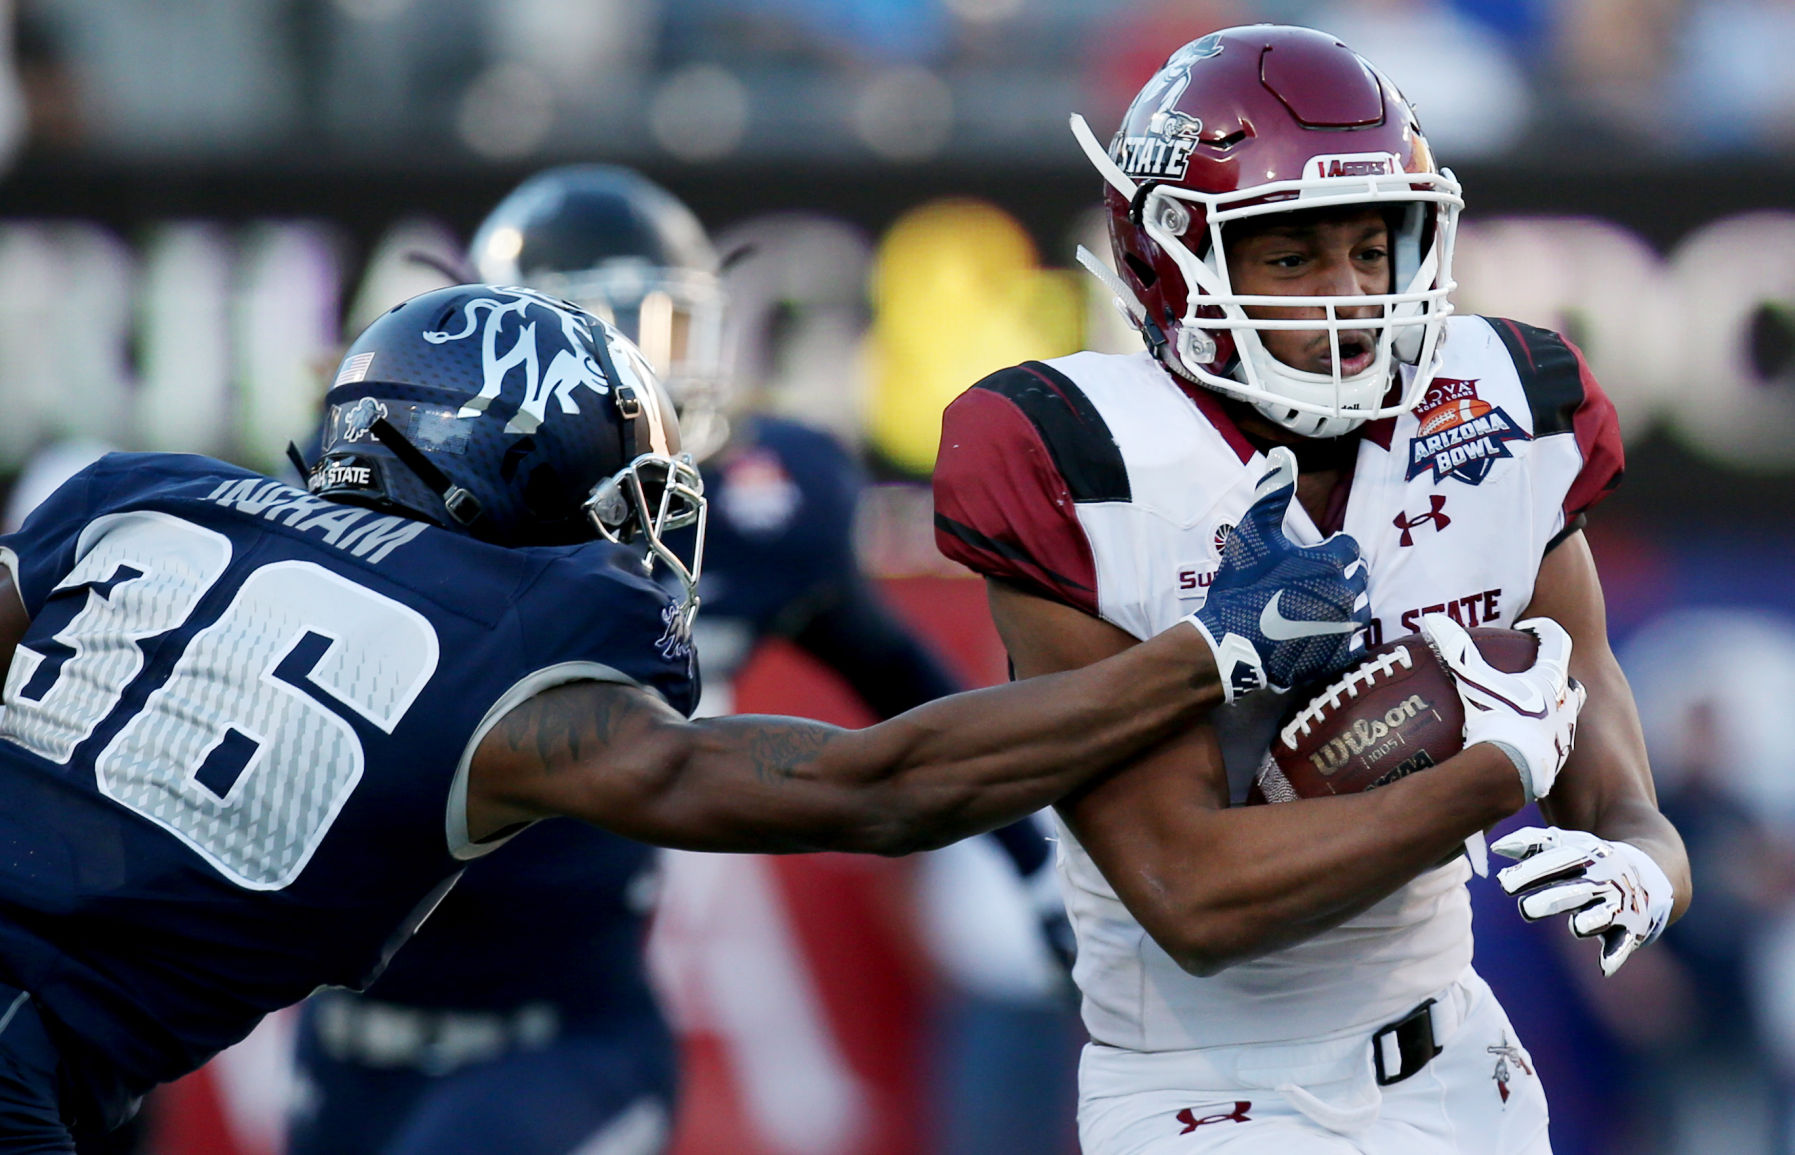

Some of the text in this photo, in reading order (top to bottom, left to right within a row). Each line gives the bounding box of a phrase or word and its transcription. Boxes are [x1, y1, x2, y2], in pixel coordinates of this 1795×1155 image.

[1119, 136, 1193, 175] STATE
[1414, 412, 1510, 464] ARIZONA
[1435, 436, 1500, 474] BOWL
[328, 466, 371, 484] STATE
[196, 478, 431, 564] INGRAM
[1180, 571, 1219, 590] Su
[0, 510, 440, 892] 36
[1309, 694, 1429, 776] Wilson
